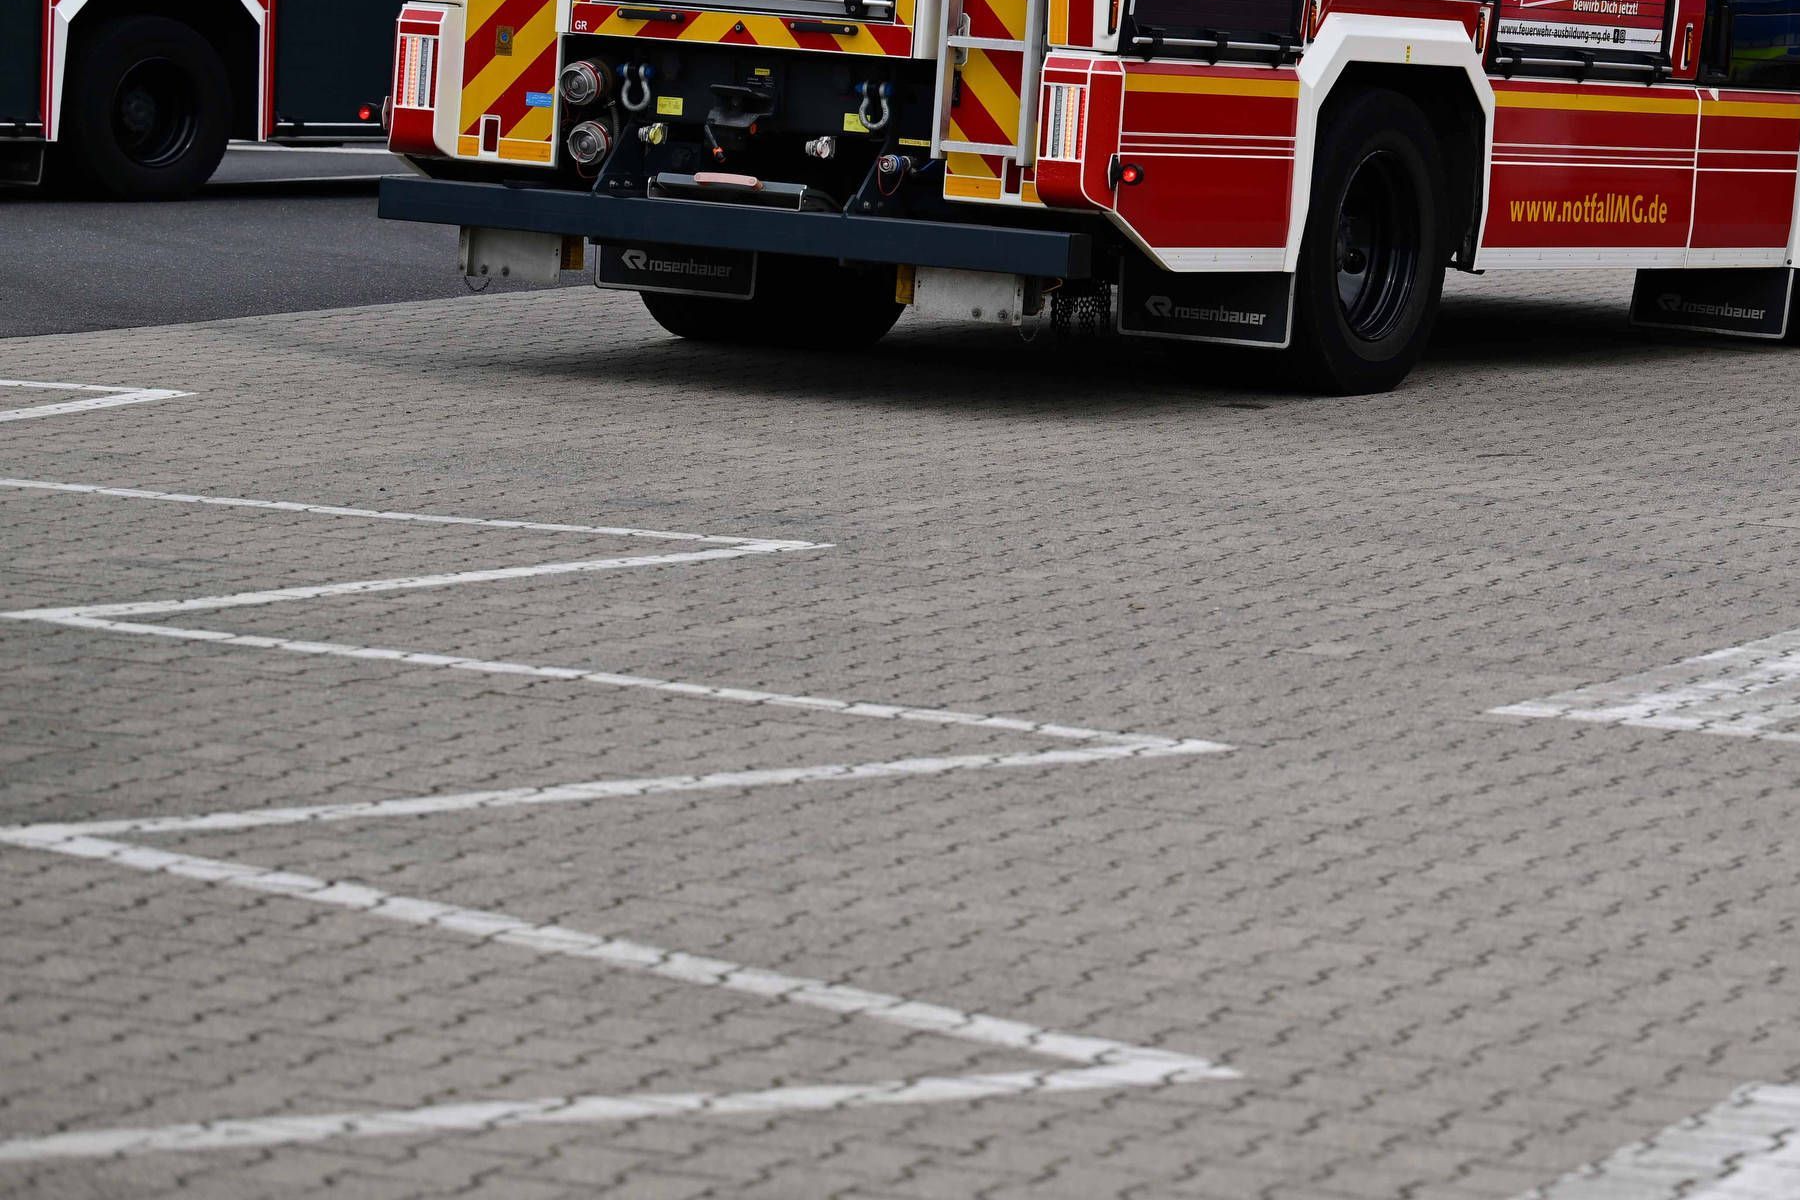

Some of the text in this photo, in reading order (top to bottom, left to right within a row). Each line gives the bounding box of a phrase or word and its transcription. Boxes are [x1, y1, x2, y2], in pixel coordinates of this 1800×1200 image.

[575, 20, 588, 31] GR
[1500, 23, 1611, 44] www.feuerwehr-ausbildung-mg.de
[1509, 192, 1668, 224] www.notfallMG.de
[649, 258, 733, 278] rosenbauer
[1174, 305, 1266, 326] rosenbauer
